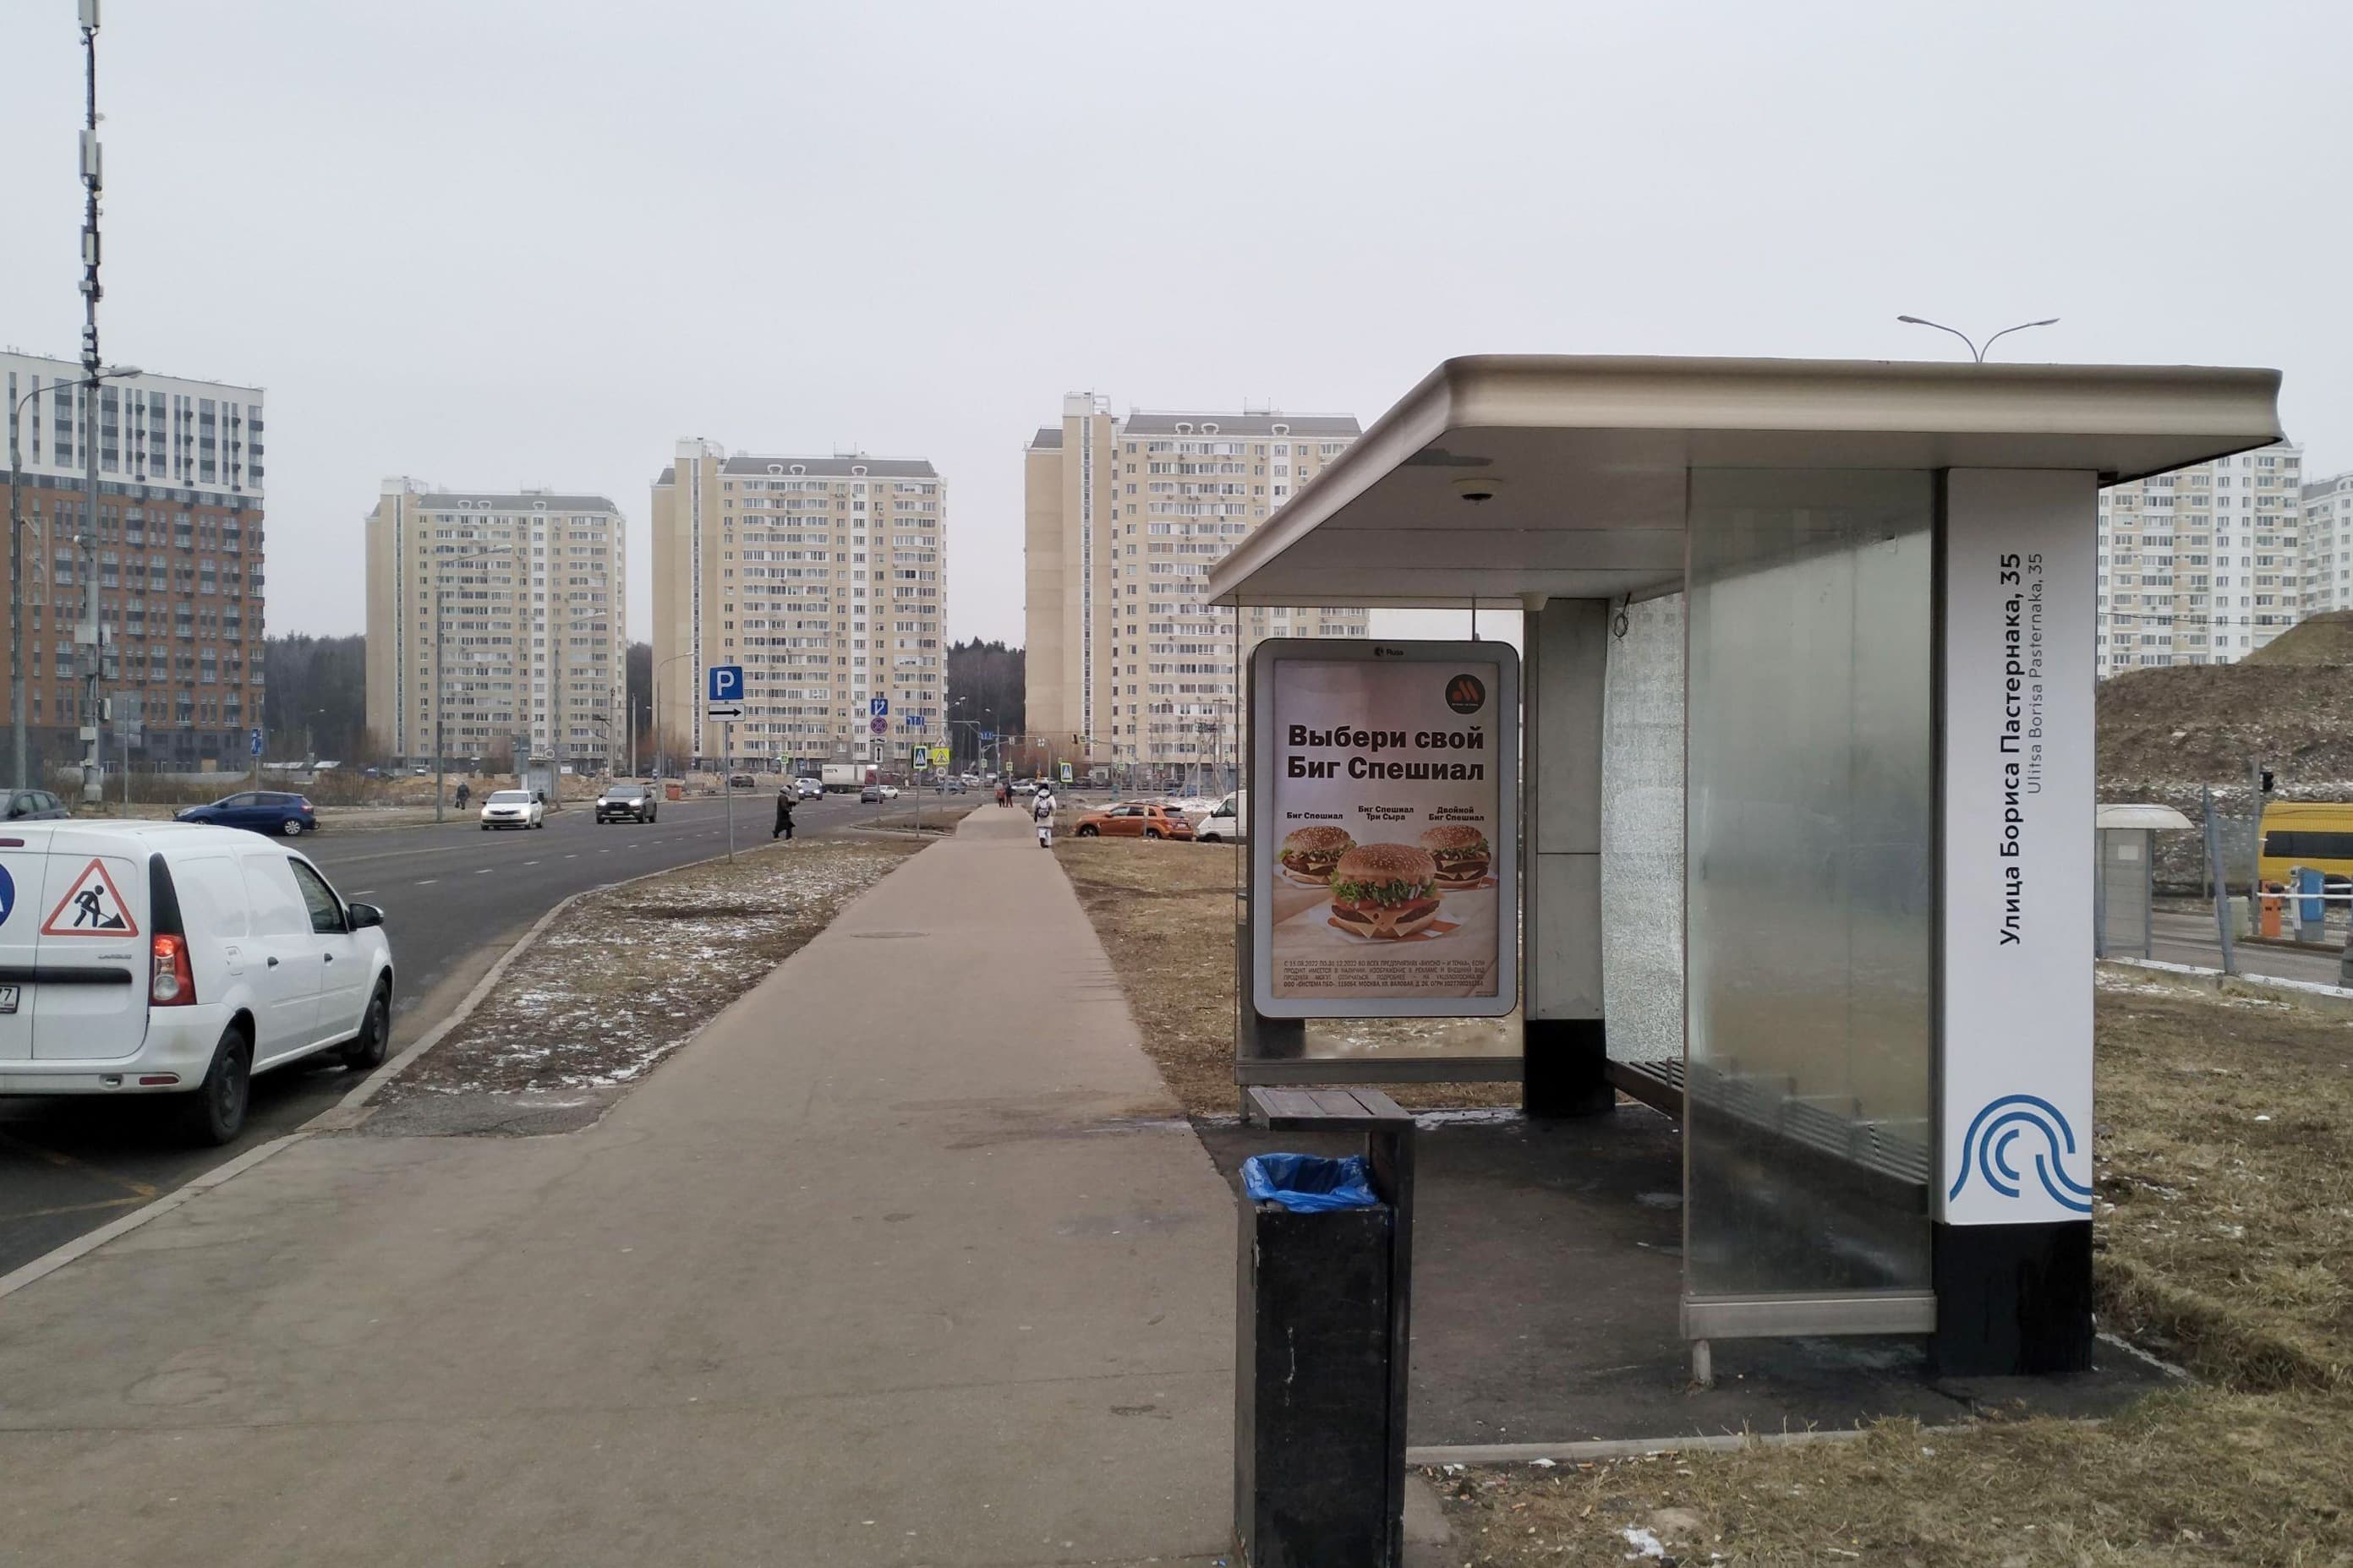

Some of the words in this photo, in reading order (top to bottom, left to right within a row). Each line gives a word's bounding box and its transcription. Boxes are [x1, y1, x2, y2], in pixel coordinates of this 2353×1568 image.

[2000, 554, 2020, 586] 35
[2029, 554, 2042, 575] 35
[2027, 579, 2043, 678] Pasternaka,
[717, 670, 735, 697] P
[2000, 593, 2025, 752] Пастернака,
[2029, 684, 2042, 738] Borisa
[1289, 724, 1407, 752] Выбери
[1415, 725, 1484, 750] свой
[1288, 756, 1340, 779] Биг
[1348, 756, 1484, 780] Спешиал
[2027, 744, 2042, 794] Ulitsa
[1366, 813, 1382, 822] Три
[1382, 813, 1405, 822] Сыра
[1436, 806, 1474, 815] Двойной
[2000, 762, 2023, 857] Бориса
[2000, 866, 2022, 945] Улица
